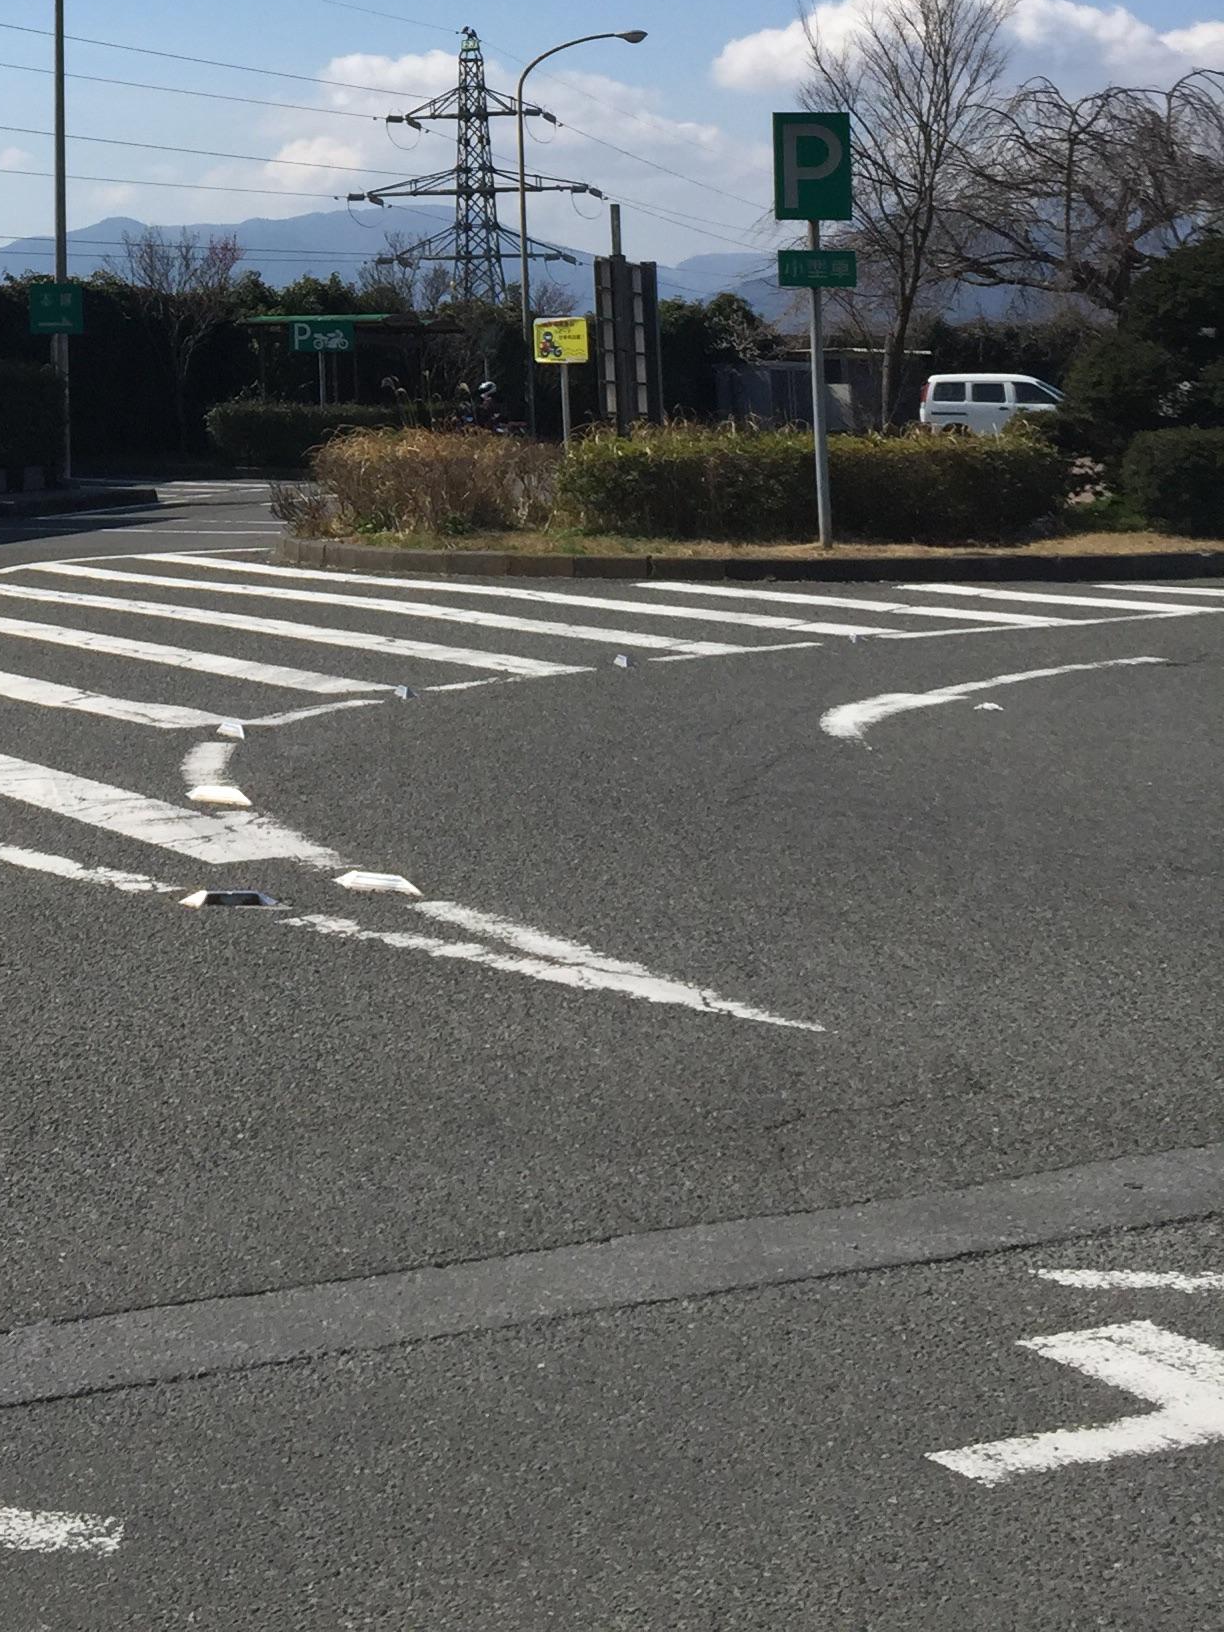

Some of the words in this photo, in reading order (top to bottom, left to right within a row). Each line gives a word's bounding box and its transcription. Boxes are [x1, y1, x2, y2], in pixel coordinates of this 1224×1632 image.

[783, 123, 843, 209] P
[785, 258, 852, 280] 小型車
[294, 322, 312, 351] P
